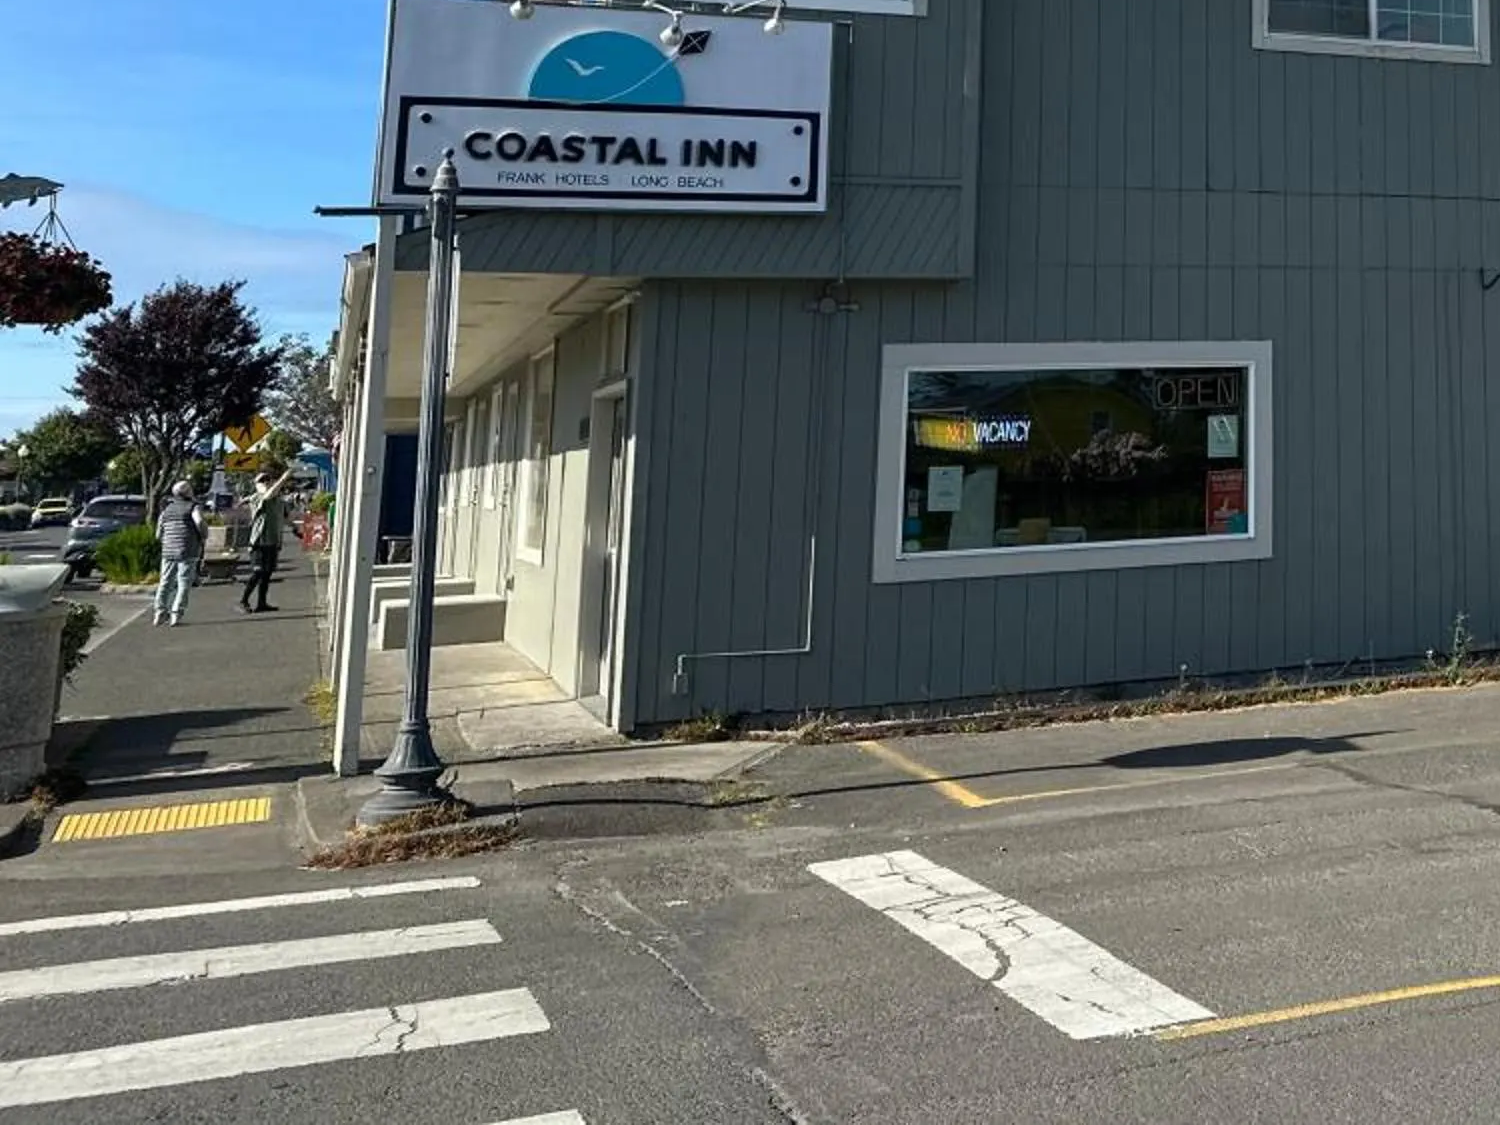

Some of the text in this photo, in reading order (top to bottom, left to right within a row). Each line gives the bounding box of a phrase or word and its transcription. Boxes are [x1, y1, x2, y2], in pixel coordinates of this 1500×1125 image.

[464, 131, 757, 169] COASTAL INN
[497, 171, 724, 189] FRANK HOTELS LONG BEACH
[1157, 377, 1235, 407] OPEN
[973, 420, 1031, 443] VACANCY
